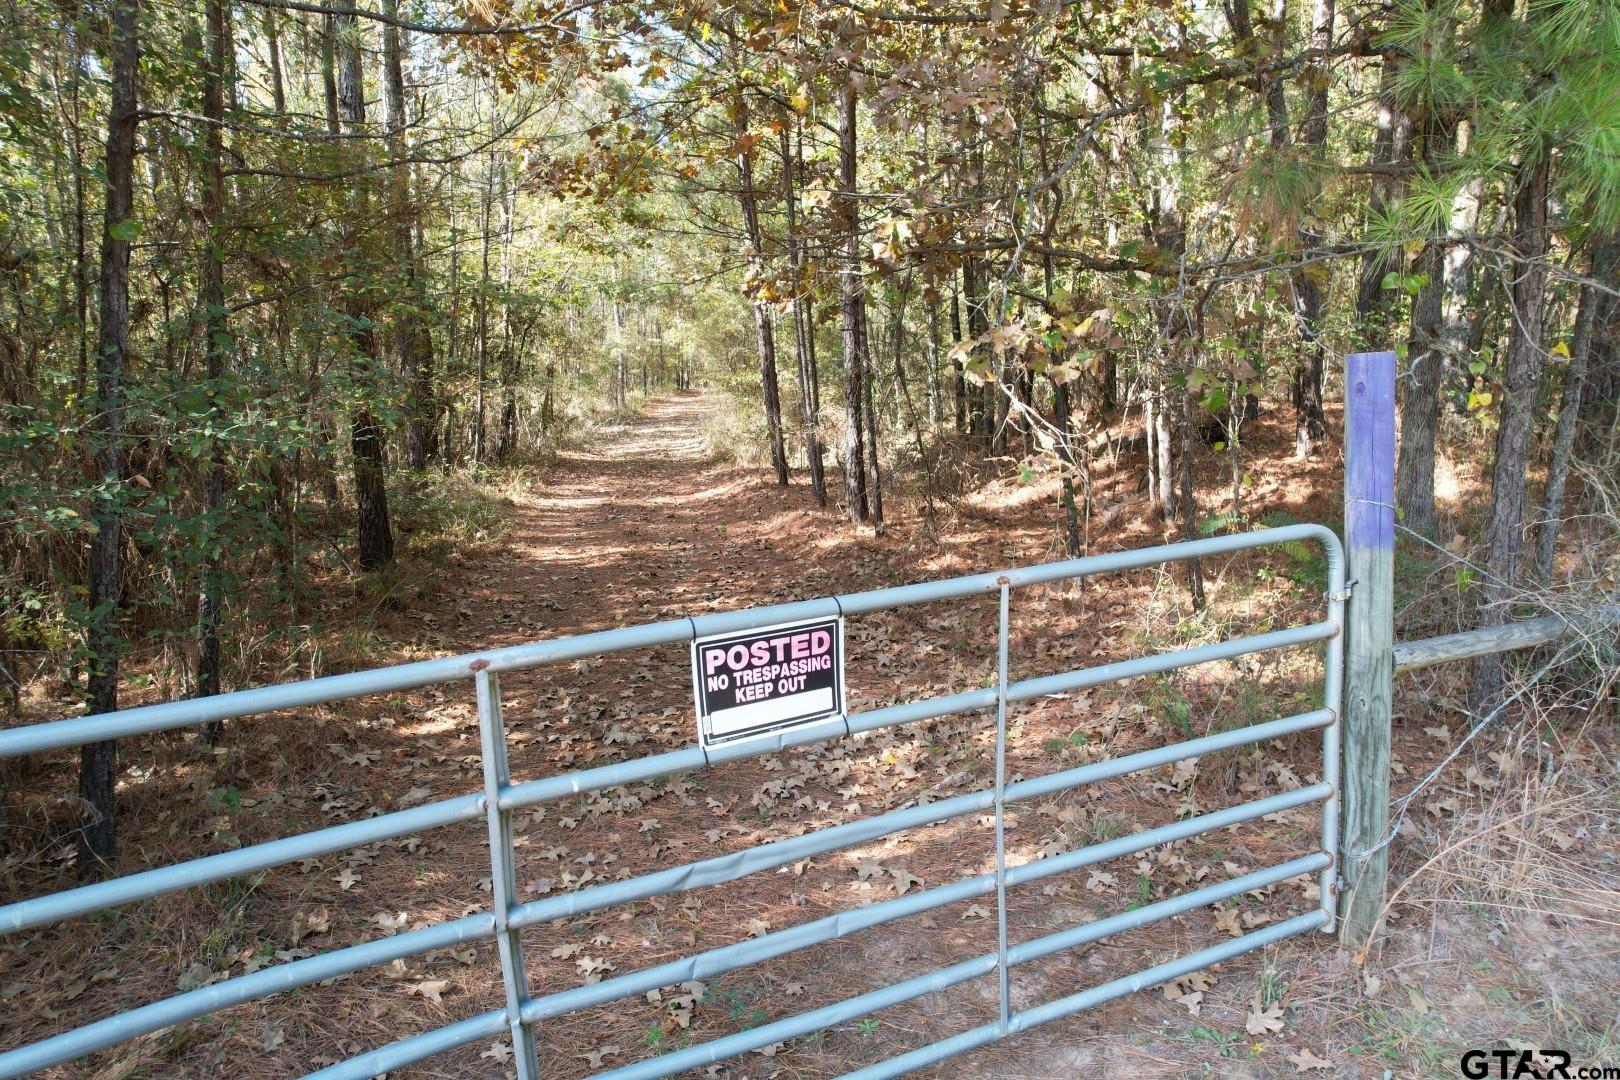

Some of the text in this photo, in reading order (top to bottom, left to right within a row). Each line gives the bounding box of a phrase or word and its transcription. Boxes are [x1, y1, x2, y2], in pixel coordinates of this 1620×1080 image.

[705, 630, 831, 675] POSTED
[707, 654, 831, 692] NO TRESPASSING
[735, 675, 807, 703] KEEP OUT
